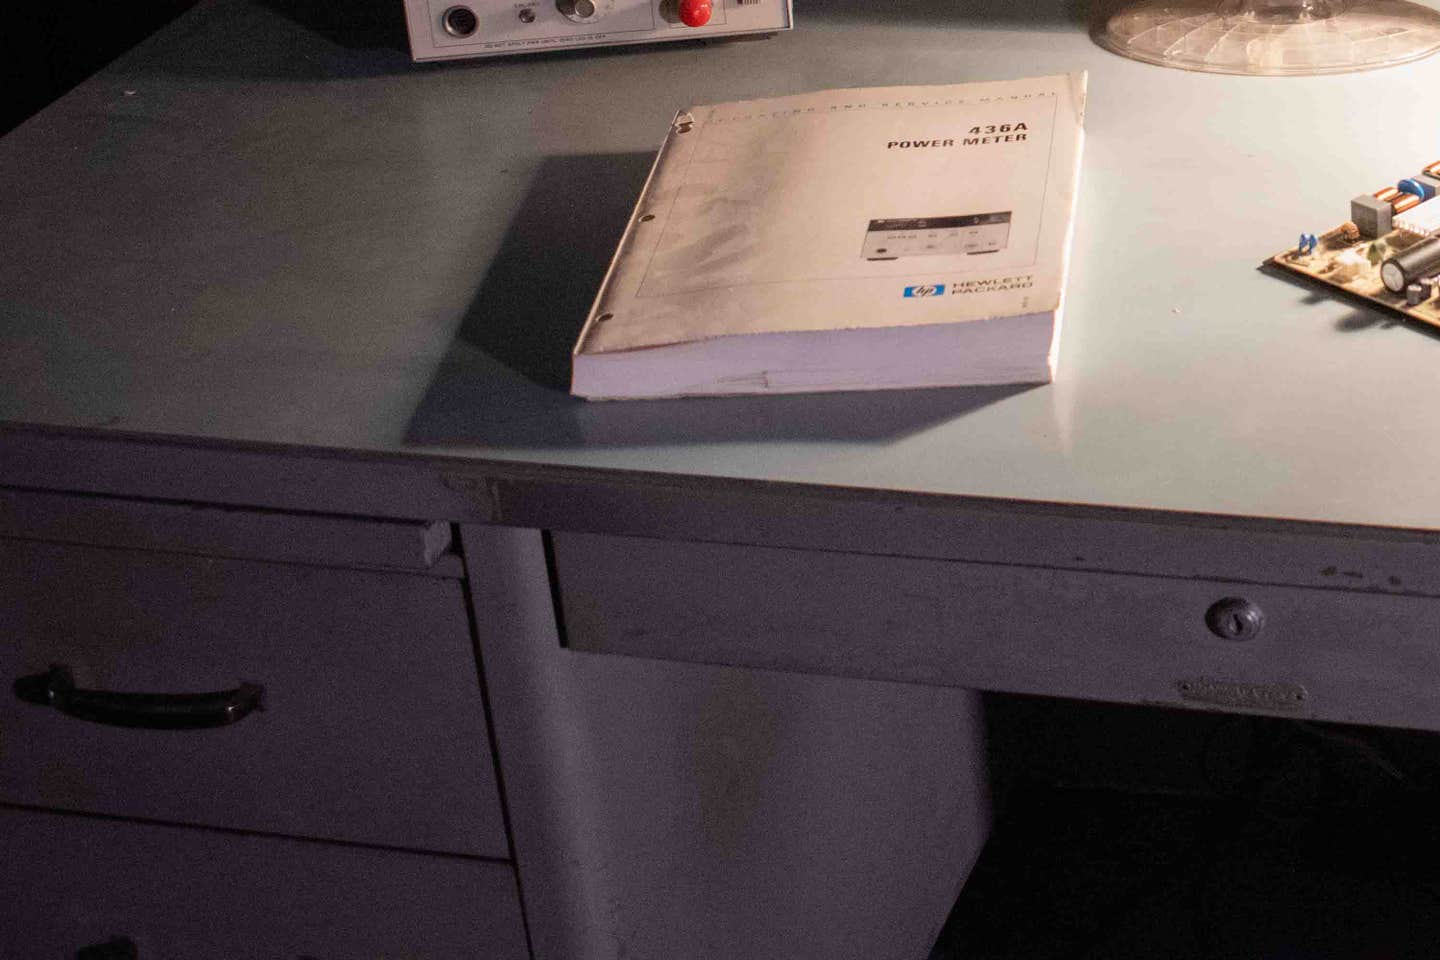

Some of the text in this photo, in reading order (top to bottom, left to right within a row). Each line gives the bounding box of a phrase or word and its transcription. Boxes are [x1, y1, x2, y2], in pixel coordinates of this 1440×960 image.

[969, 122, 1028, 135] 436A
[887, 133, 1027, 149] POWER METER
[952, 275, 1033, 288] HEWLETT
[952, 282, 1033, 295] PACKARD
